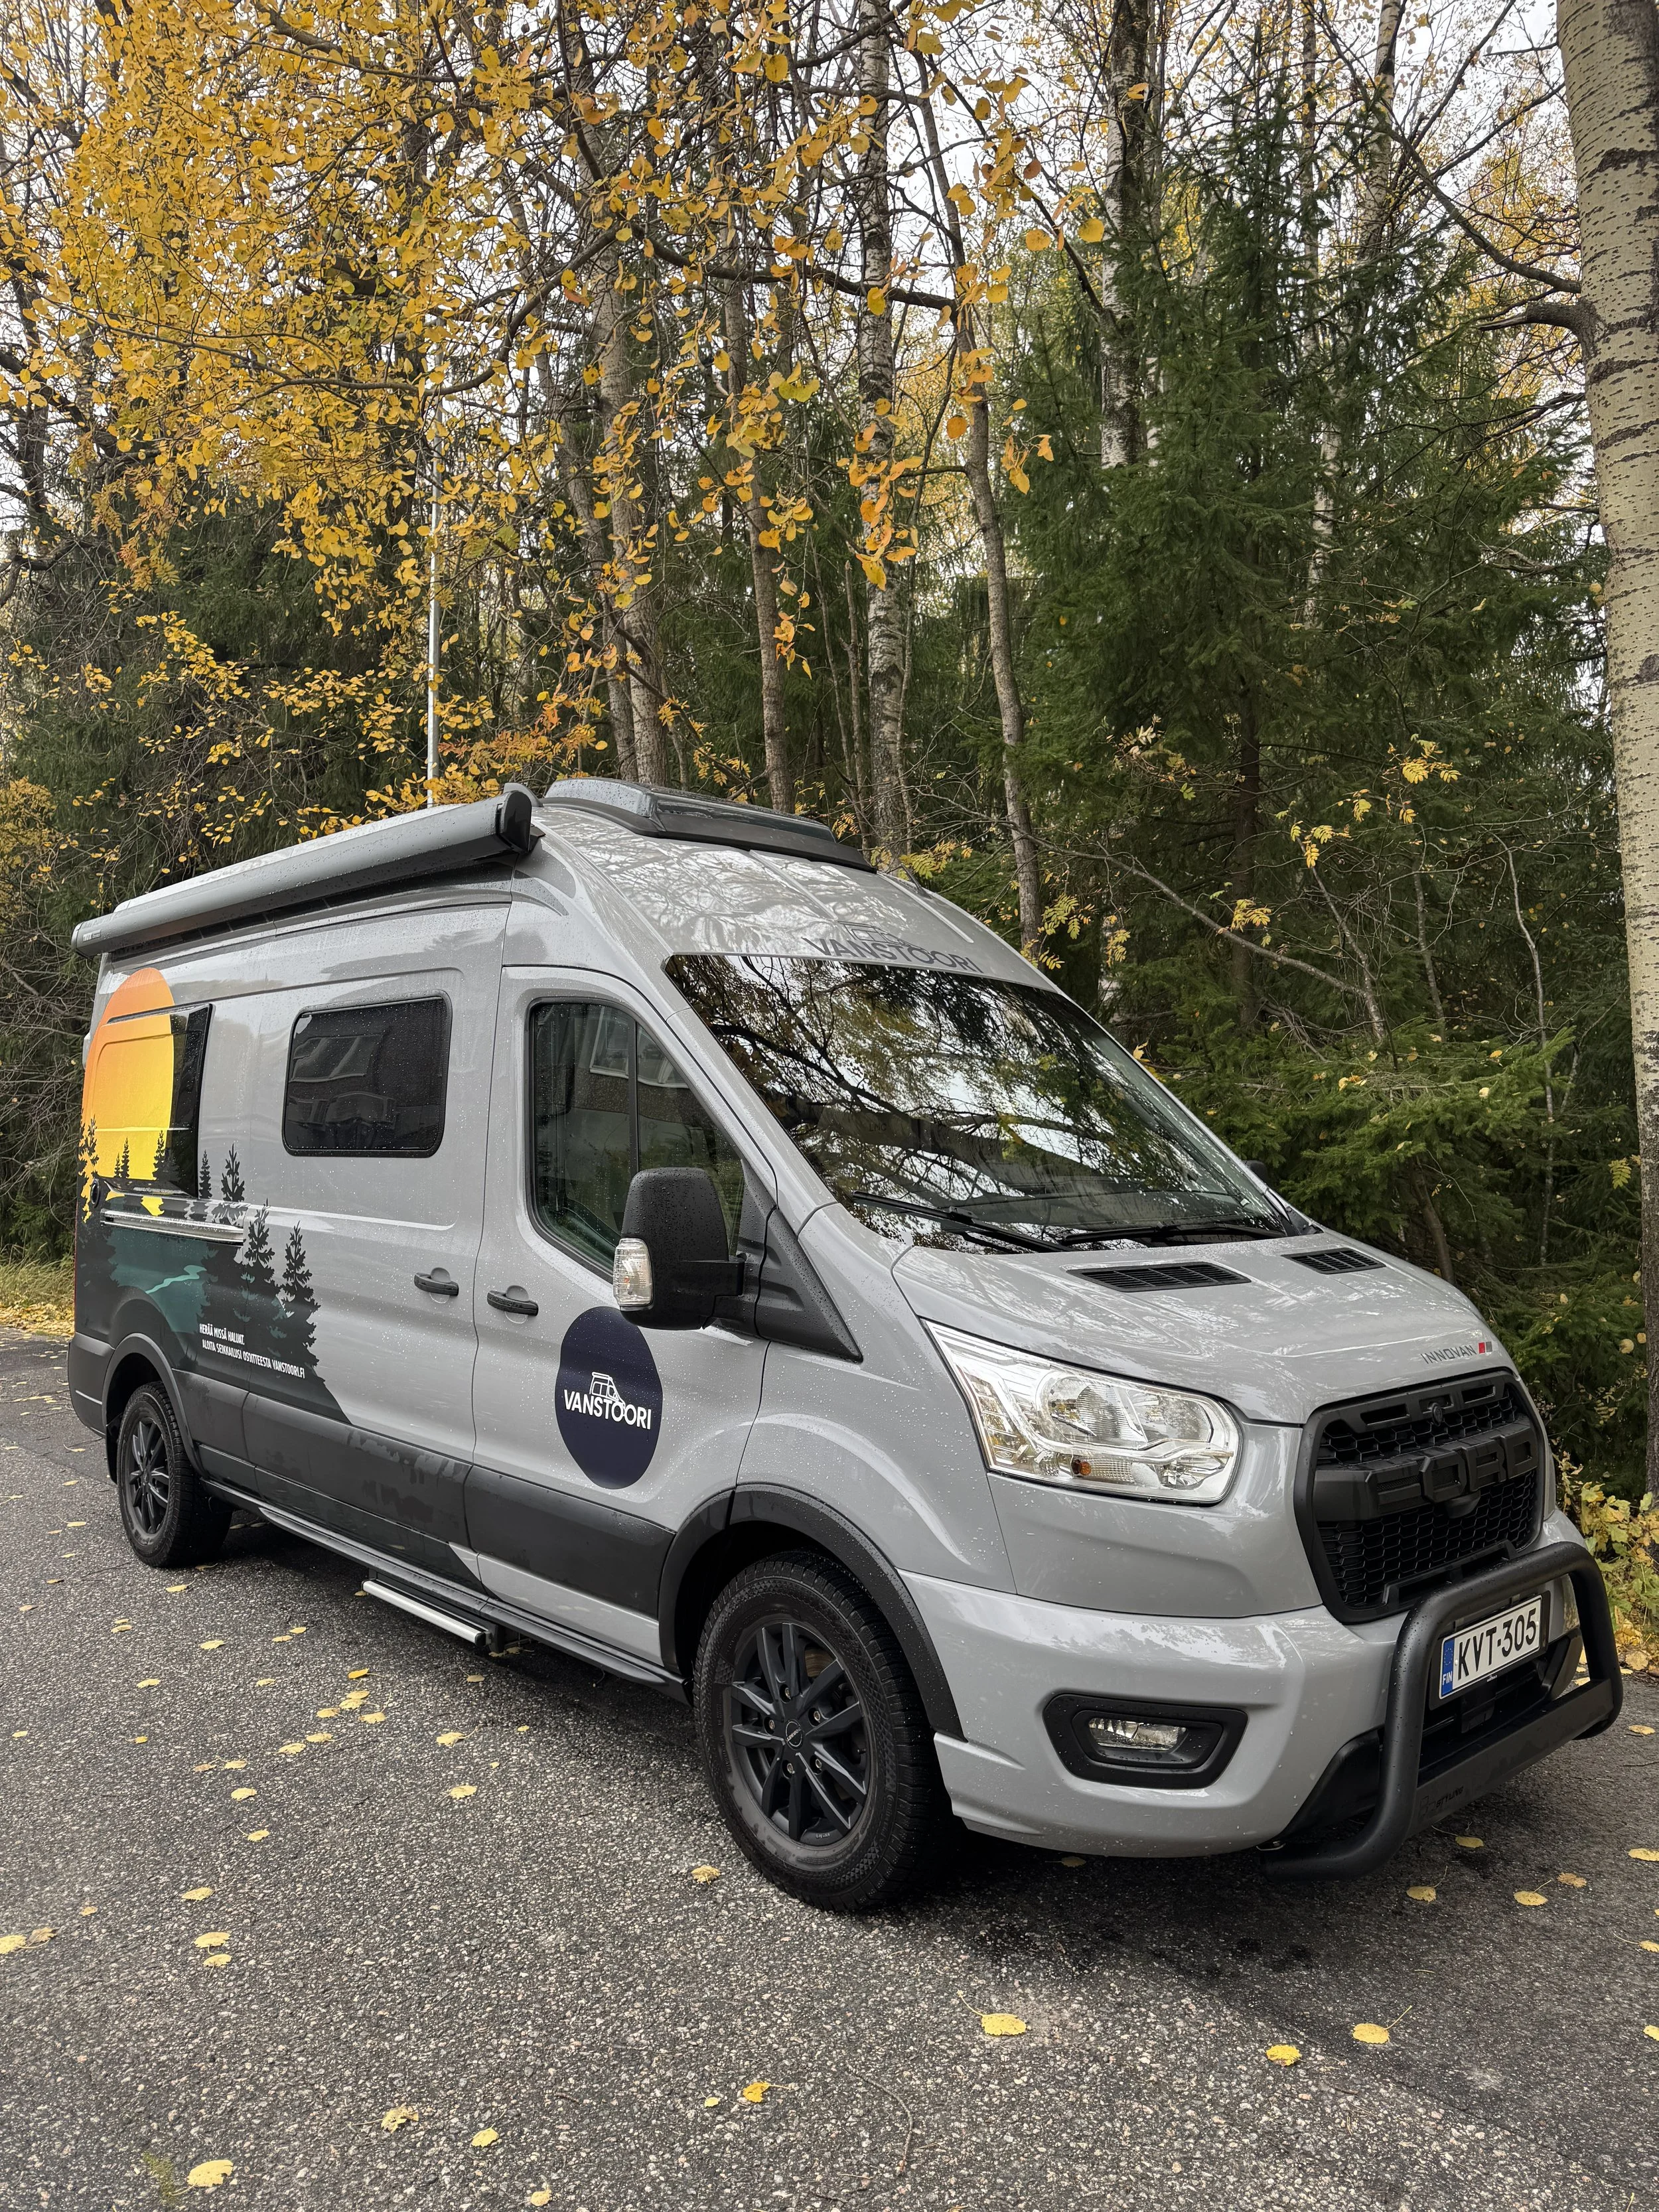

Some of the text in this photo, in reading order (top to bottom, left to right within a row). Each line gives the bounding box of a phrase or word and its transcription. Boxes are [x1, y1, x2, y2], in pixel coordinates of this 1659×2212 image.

[802, 937, 984, 973] VANSTOORI
[869, 1123, 887, 1132] LMC
[199, 1323, 245, 1345] HERÄÄ MISSÄ HALUAT.
[202, 1339, 216, 1352] ALOITA
[216, 1343, 242, 1360] SEIKKAILUSI
[272, 1359, 305, 1379] VANSTOORI.FI
[1420, 1345, 1477, 1364] INNOVAN
[564, 1389, 652, 1430] VANSTOORI
[1365, 1427, 1538, 1520] FORD
[1458, 1607, 1537, 1680] KVT-305
[1442, 1670, 1453, 1686] FIN
